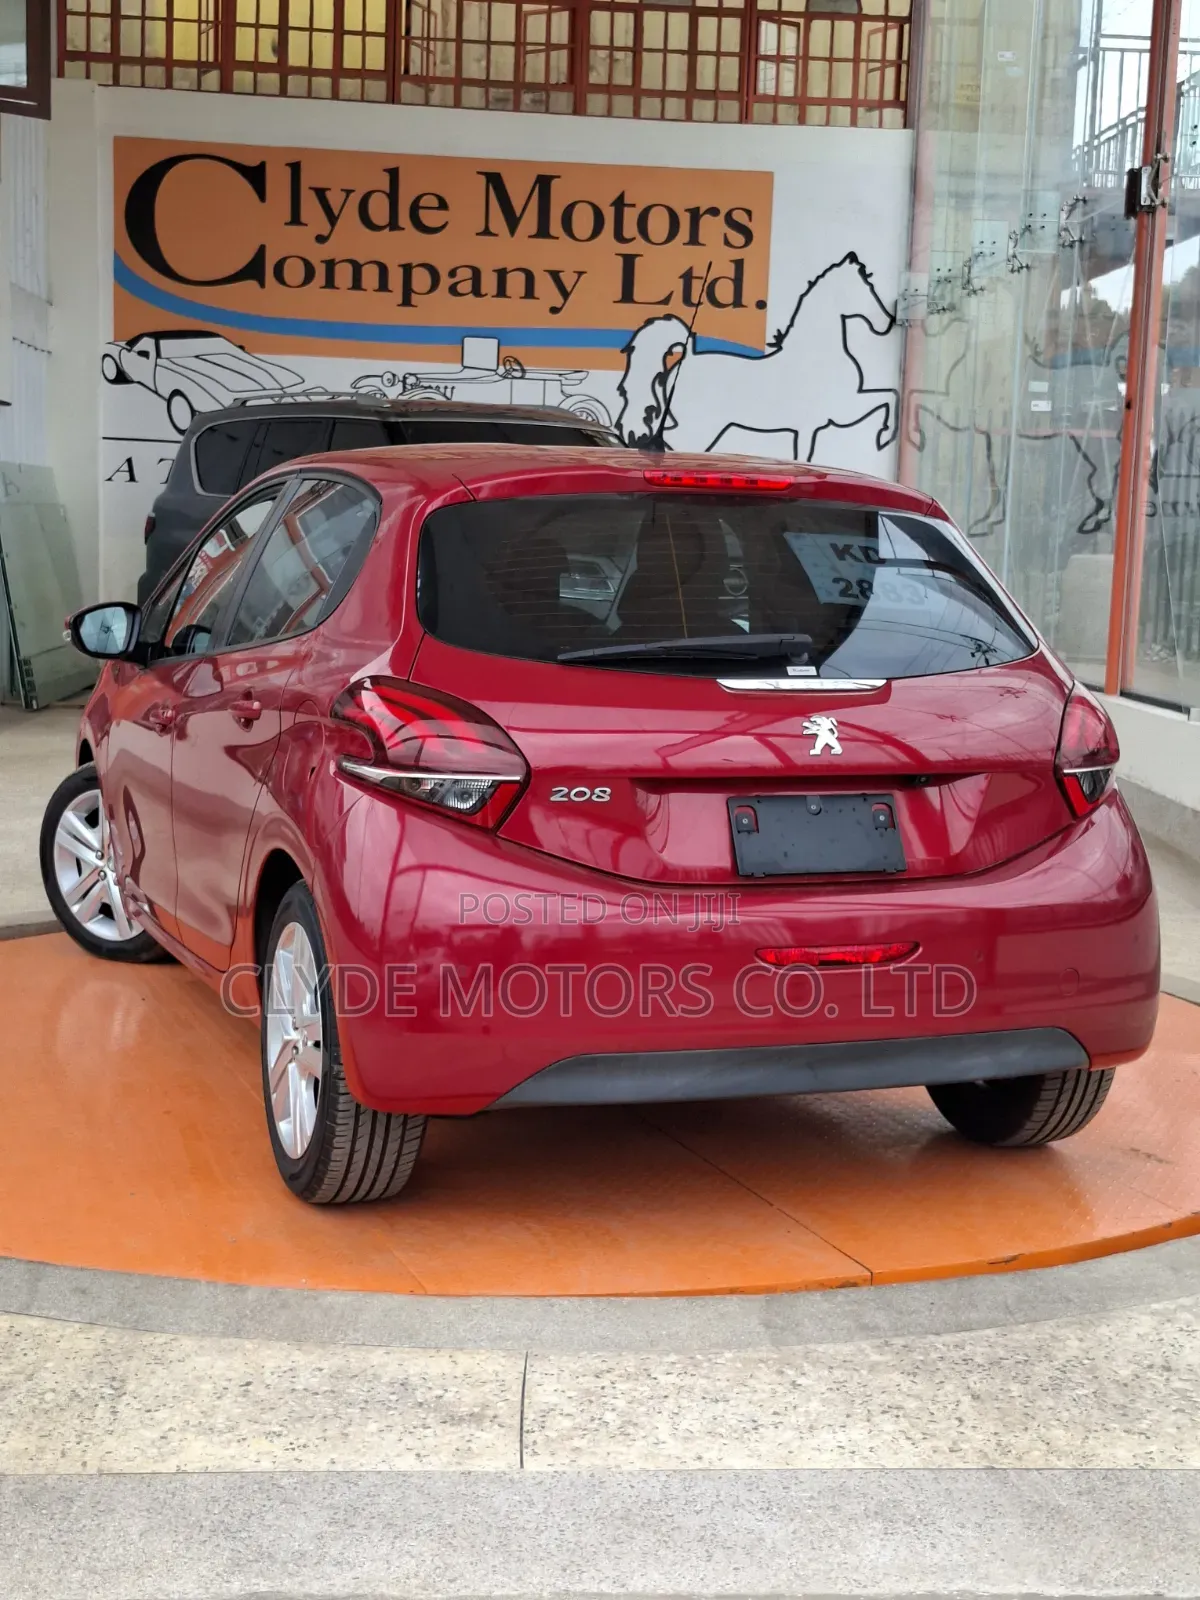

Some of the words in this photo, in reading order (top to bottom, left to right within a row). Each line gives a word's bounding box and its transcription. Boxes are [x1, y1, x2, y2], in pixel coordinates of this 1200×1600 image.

[125, 153, 450, 287] Clyde
[475, 170, 754, 249] Motors
[612, 252, 767, 310] Ltd.
[104, 456, 139, 483] A
[550, 786, 612, 802] 208
